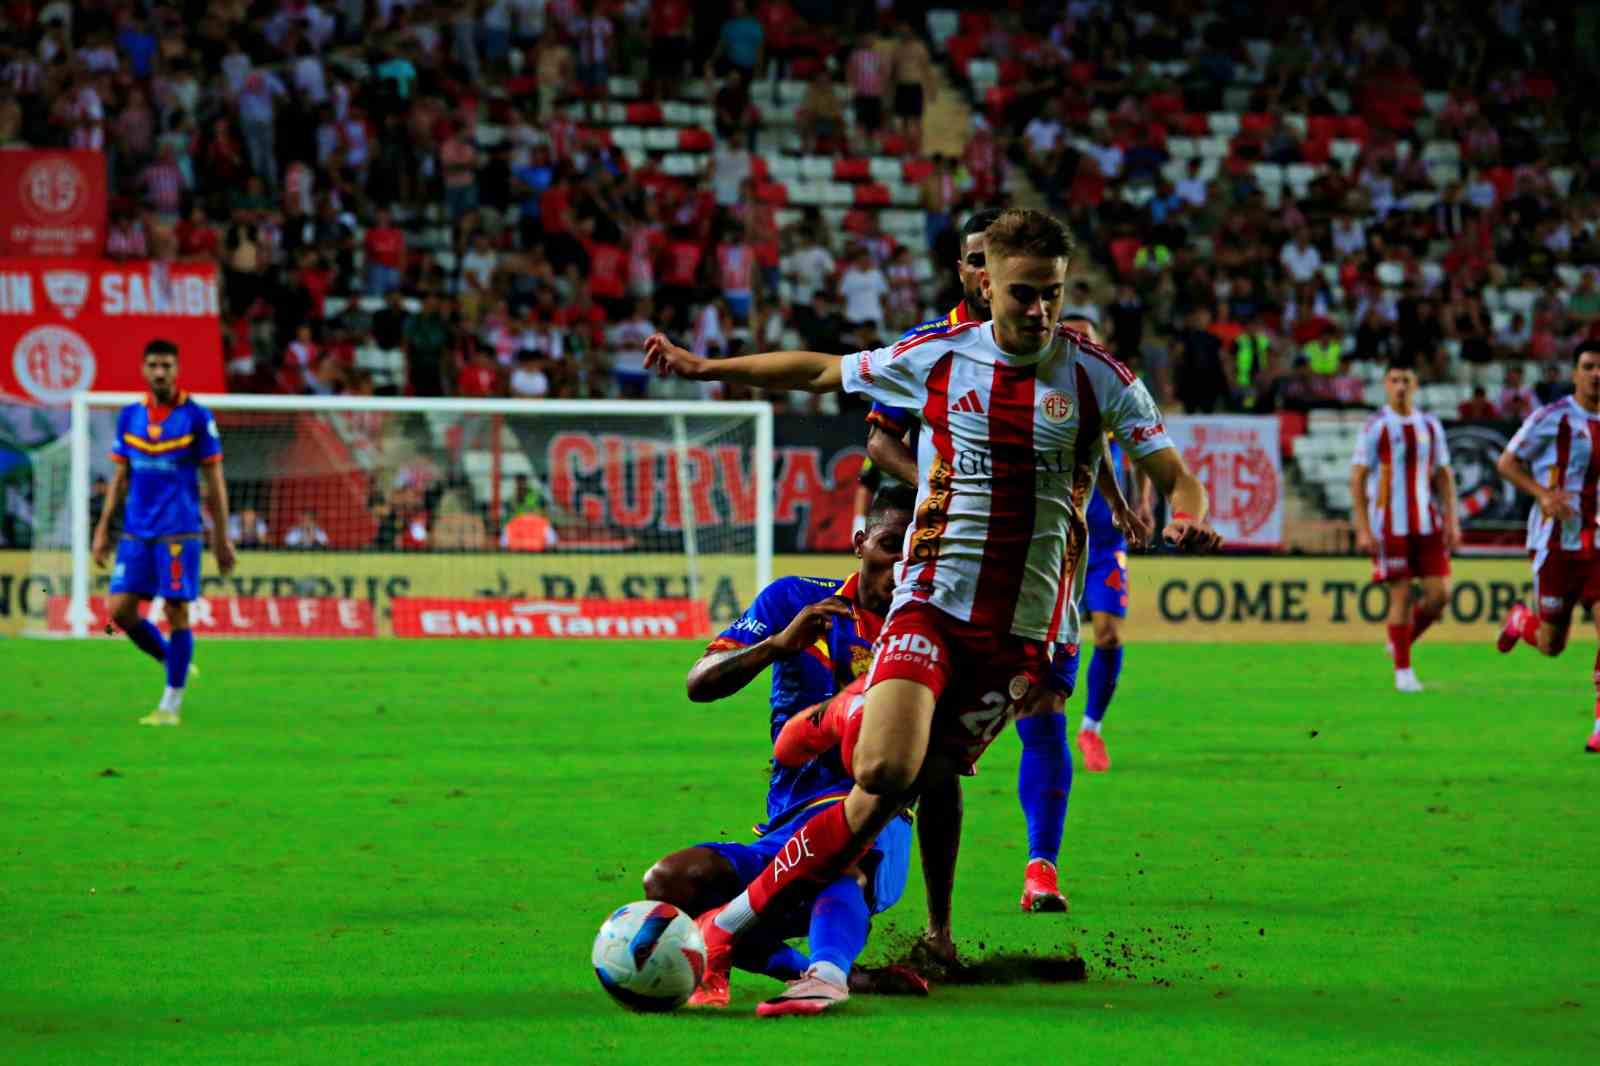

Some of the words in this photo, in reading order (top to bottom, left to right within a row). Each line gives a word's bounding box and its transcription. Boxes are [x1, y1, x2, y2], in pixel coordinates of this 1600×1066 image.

[1157, 581, 1308, 623] COME
[1322, 581, 1392, 623] TO
[886, 633, 940, 661] HDI
[773, 825, 815, 883] ADE
